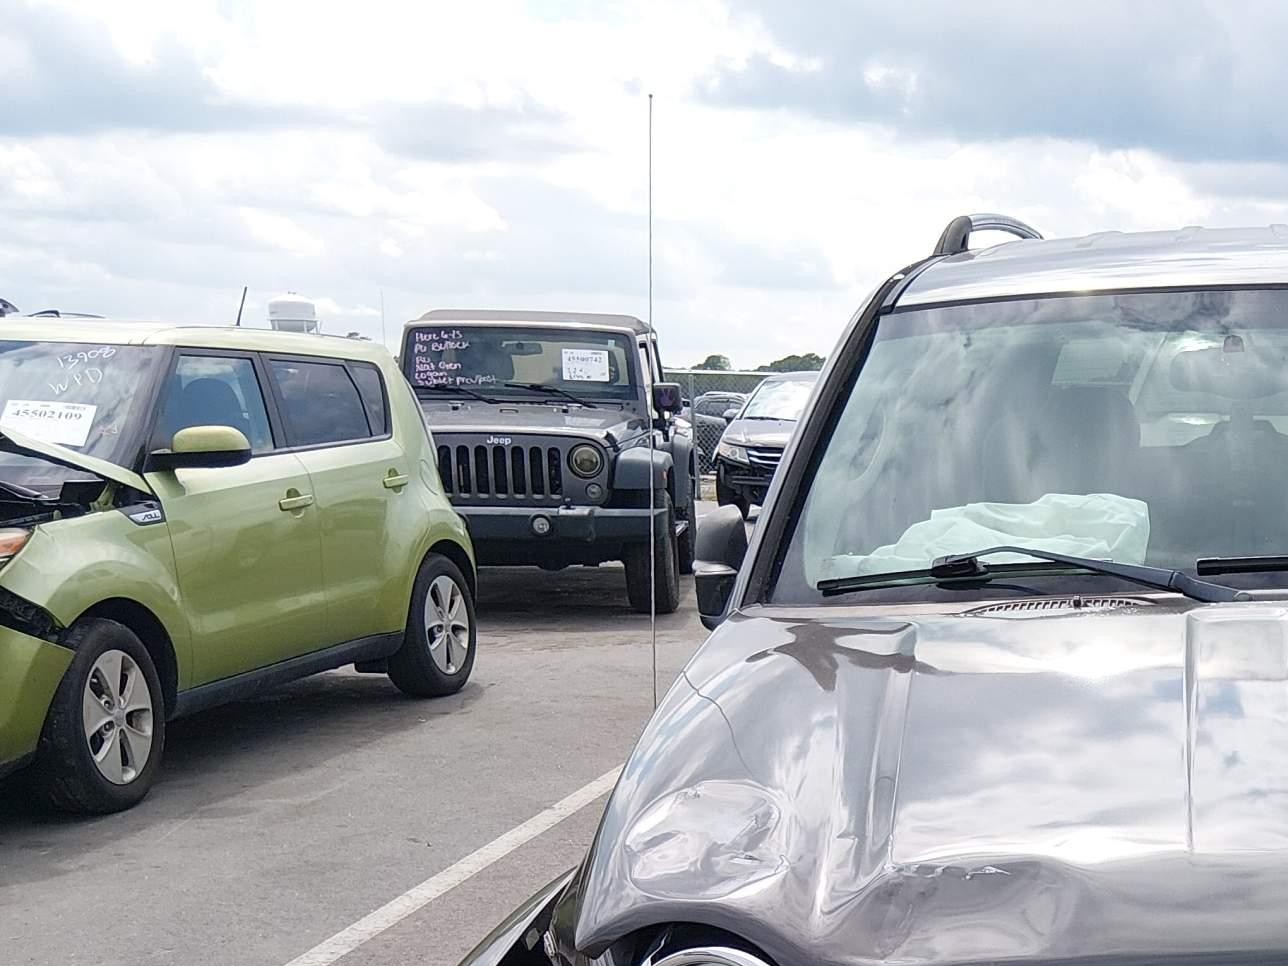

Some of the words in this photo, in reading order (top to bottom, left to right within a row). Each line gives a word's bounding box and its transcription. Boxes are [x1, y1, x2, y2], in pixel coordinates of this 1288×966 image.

[57, 345, 116, 369] 13908
[12, 409, 82, 420] 45502109
[487, 435, 512, 446] Jeep
